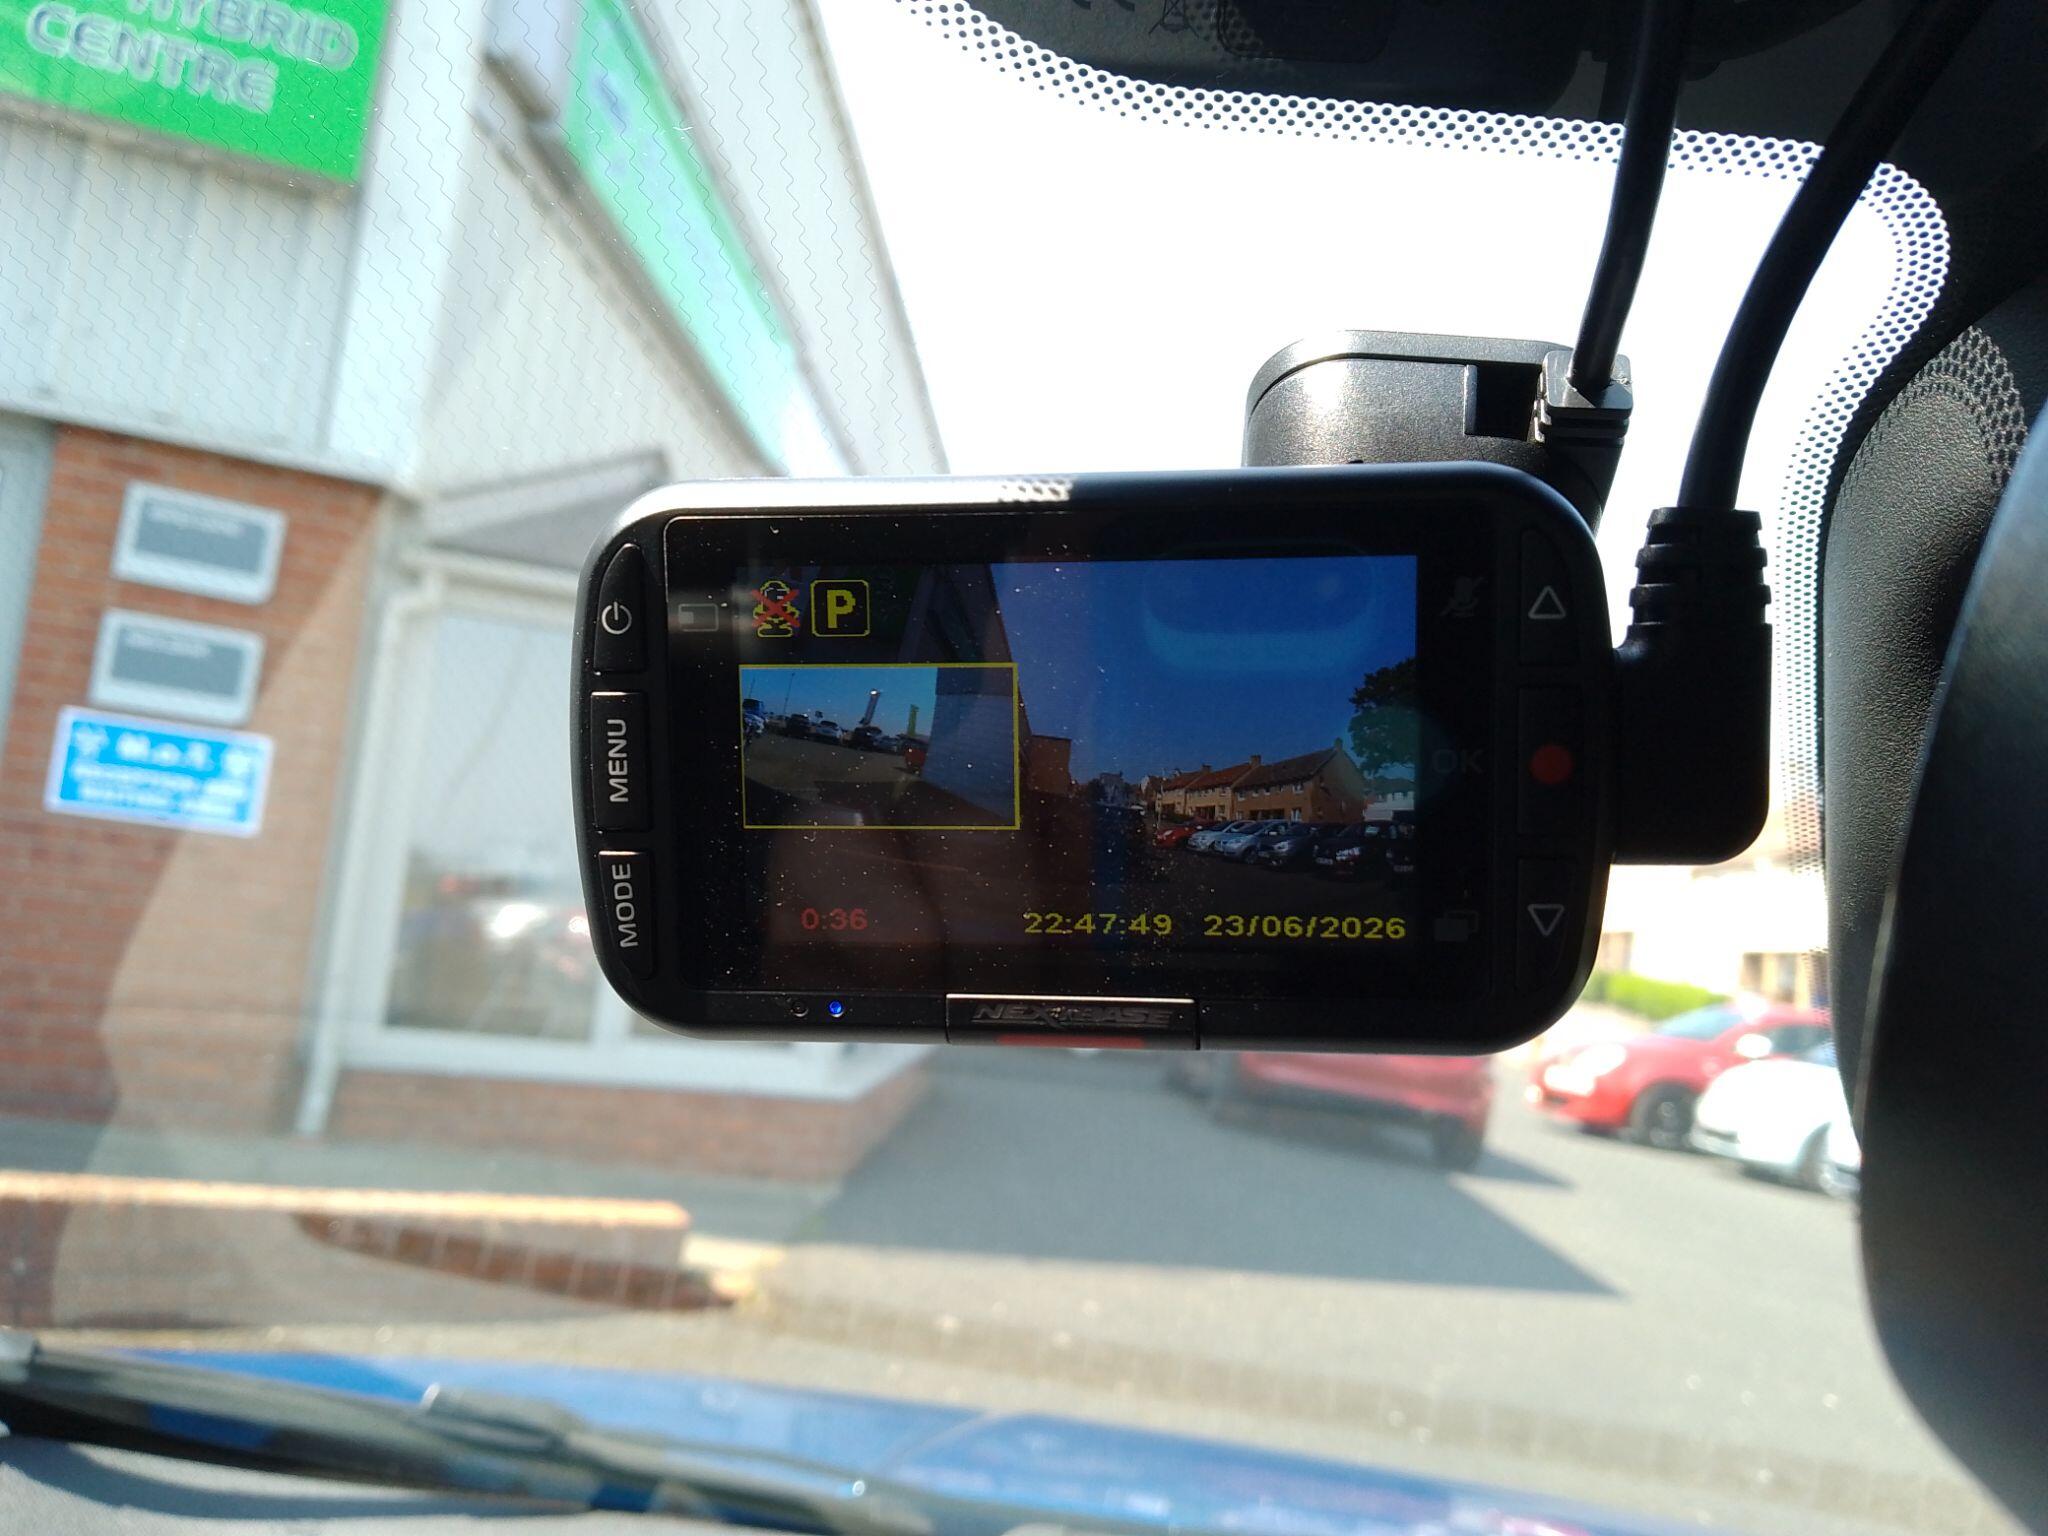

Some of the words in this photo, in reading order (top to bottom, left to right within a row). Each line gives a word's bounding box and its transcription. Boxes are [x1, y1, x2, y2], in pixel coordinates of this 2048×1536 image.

[25, 3, 279, 115] CENTRE
[128, 0, 359, 71] BRID
[827, 589, 856, 629] P
[607, 718, 629, 803] MENU
[1431, 749, 1484, 774] OK
[612, 862, 639, 948] MODE
[800, 907, 869, 931] 0:36
[1023, 912, 1174, 936] 22:47:49
[1203, 914, 1407, 940] 23/06/2026
